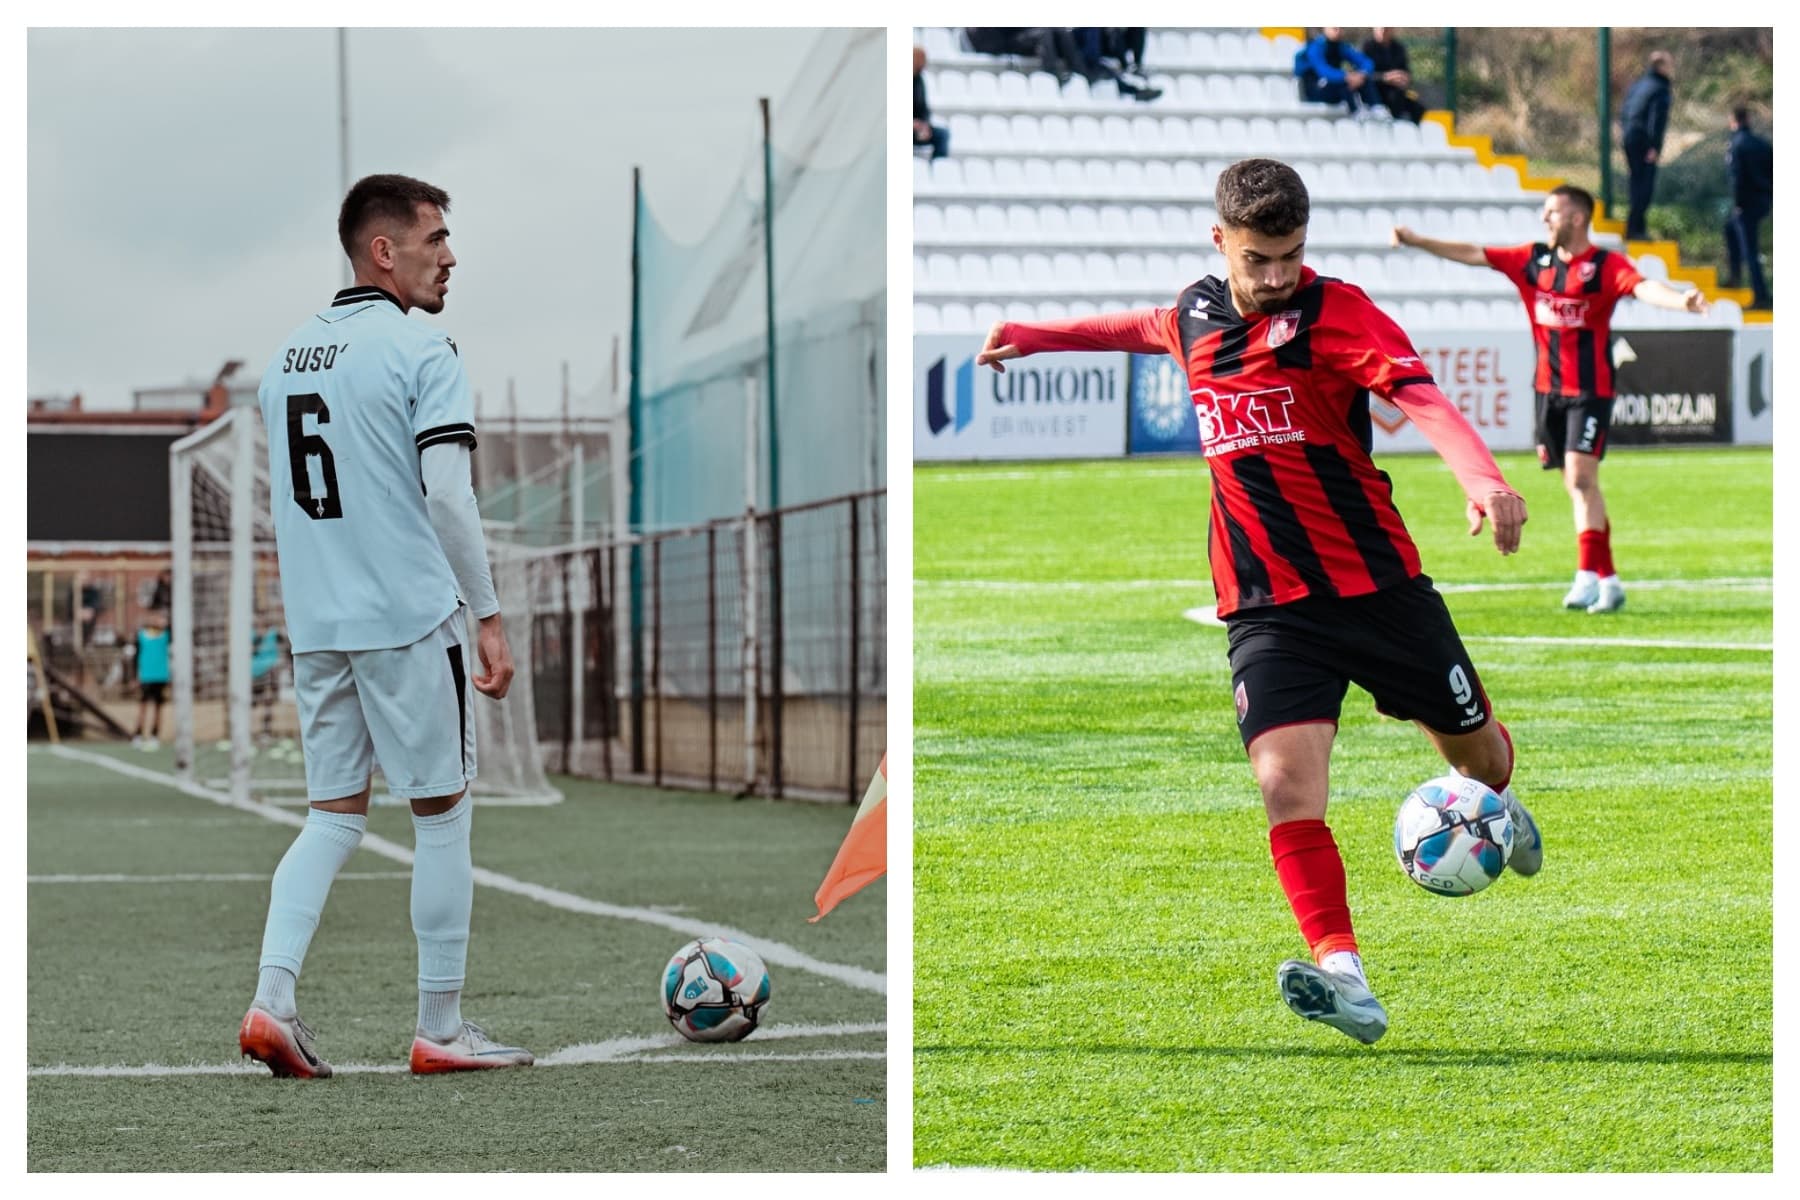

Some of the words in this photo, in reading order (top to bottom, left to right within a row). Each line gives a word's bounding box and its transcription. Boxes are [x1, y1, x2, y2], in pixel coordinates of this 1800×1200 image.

[1190, 386, 1294, 446] BKT
[1583, 416, 1598, 440] 5
[287, 392, 343, 520] 6
[1449, 664, 1472, 705] 9
